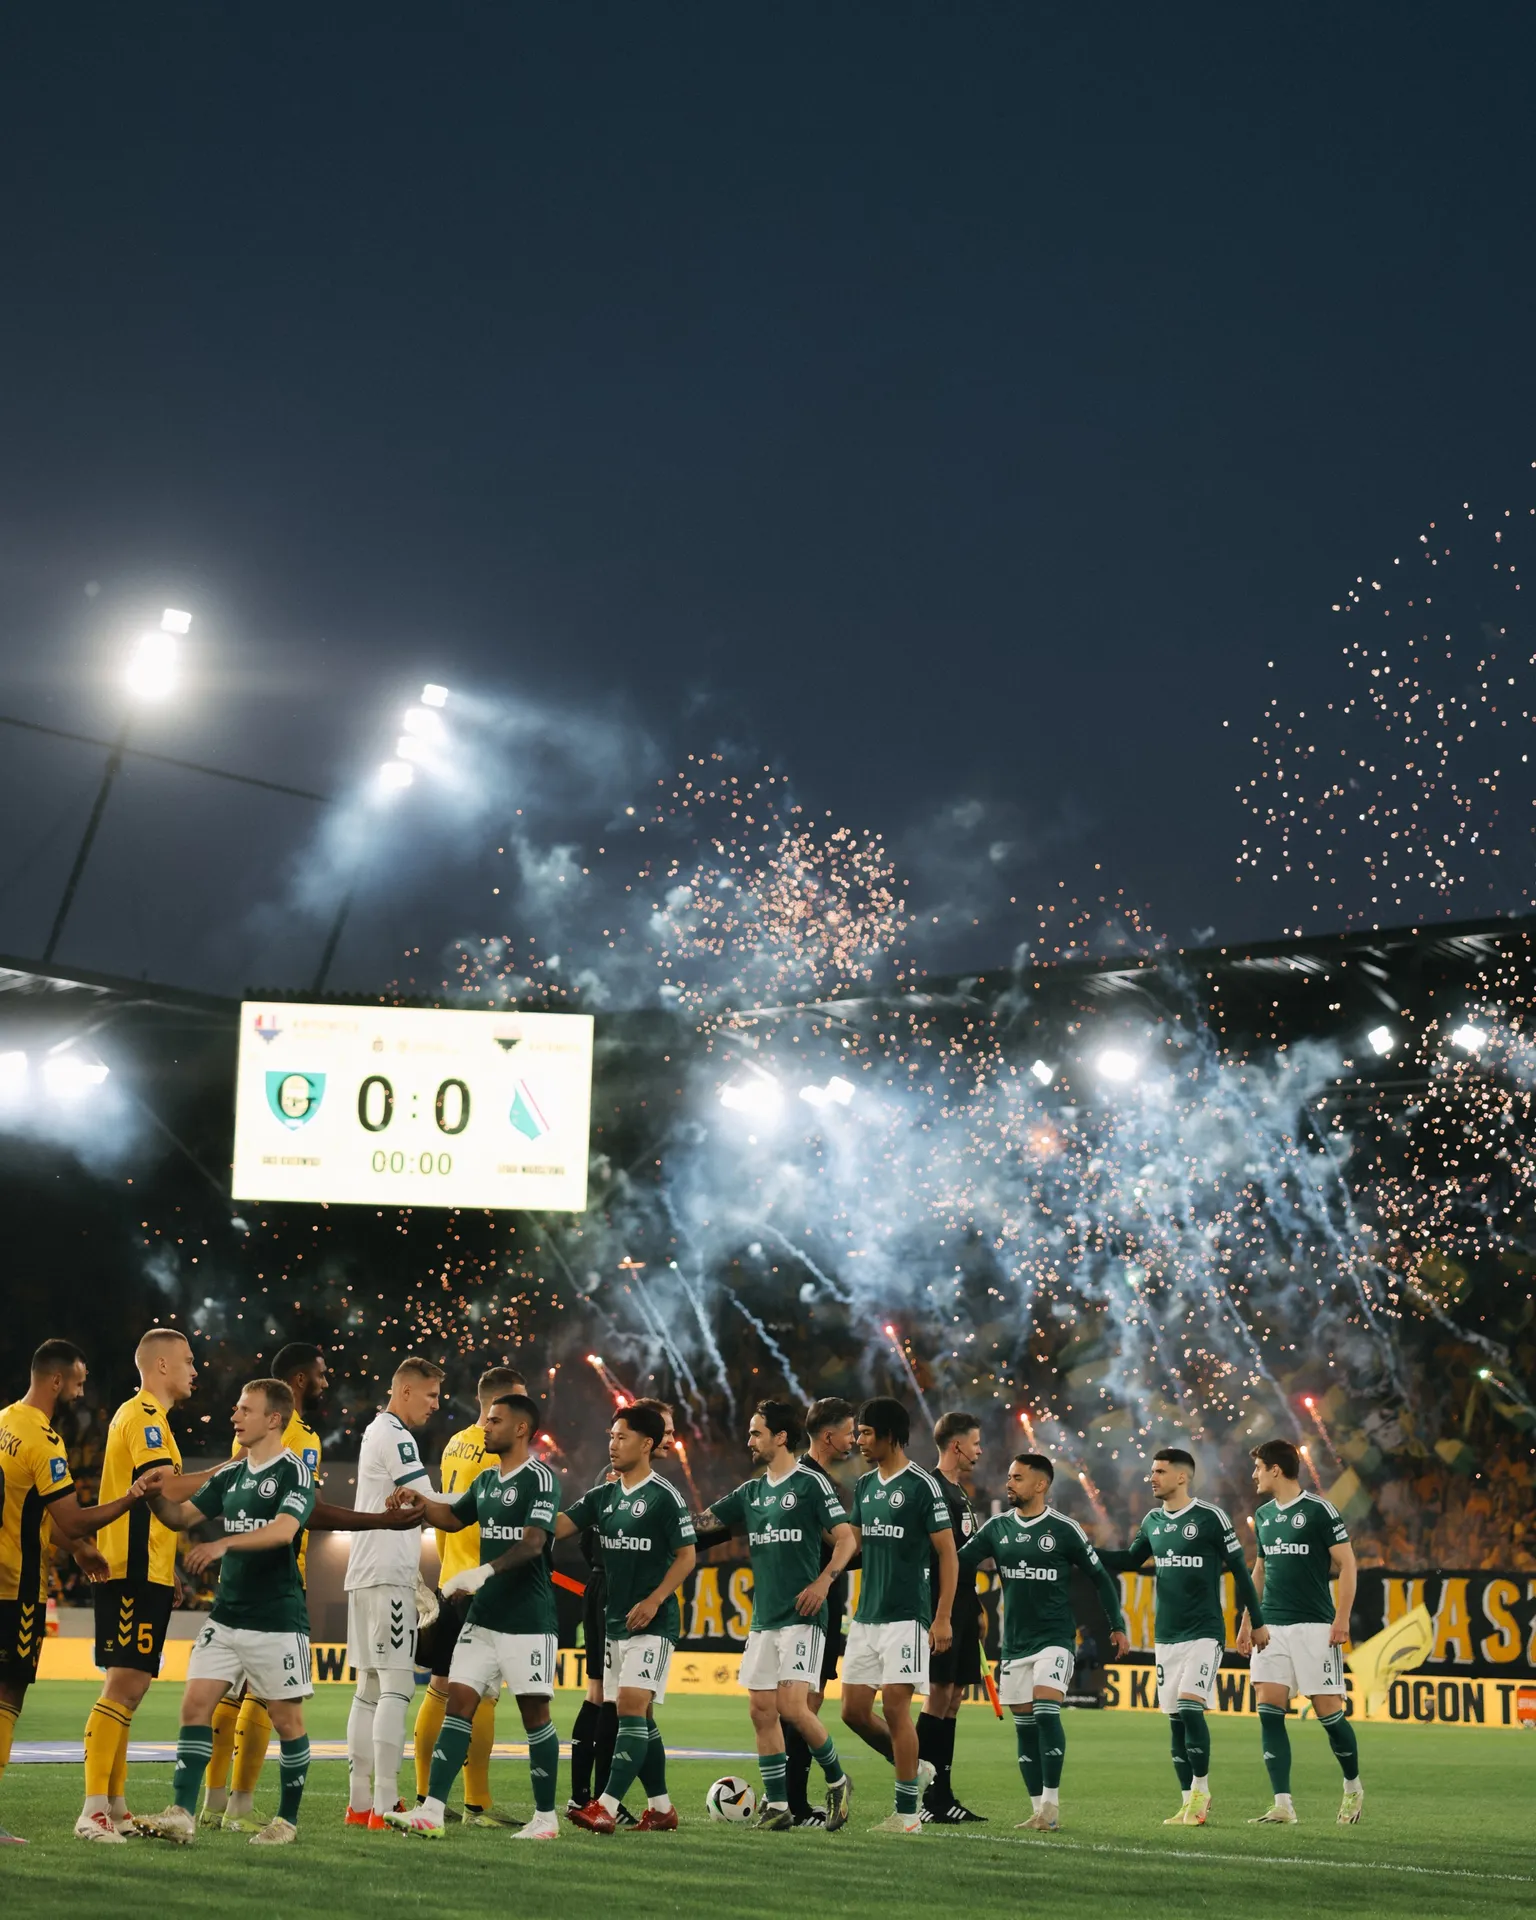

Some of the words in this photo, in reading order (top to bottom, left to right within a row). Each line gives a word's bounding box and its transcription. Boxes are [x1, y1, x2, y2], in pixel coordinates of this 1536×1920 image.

[372, 1150, 452, 1175] 00:00
[749, 1529, 802, 1546] Plus500
[861, 1523, 904, 1539] lus500
[600, 1535, 652, 1551] Plus500
[137, 1623, 154, 1654] 5
